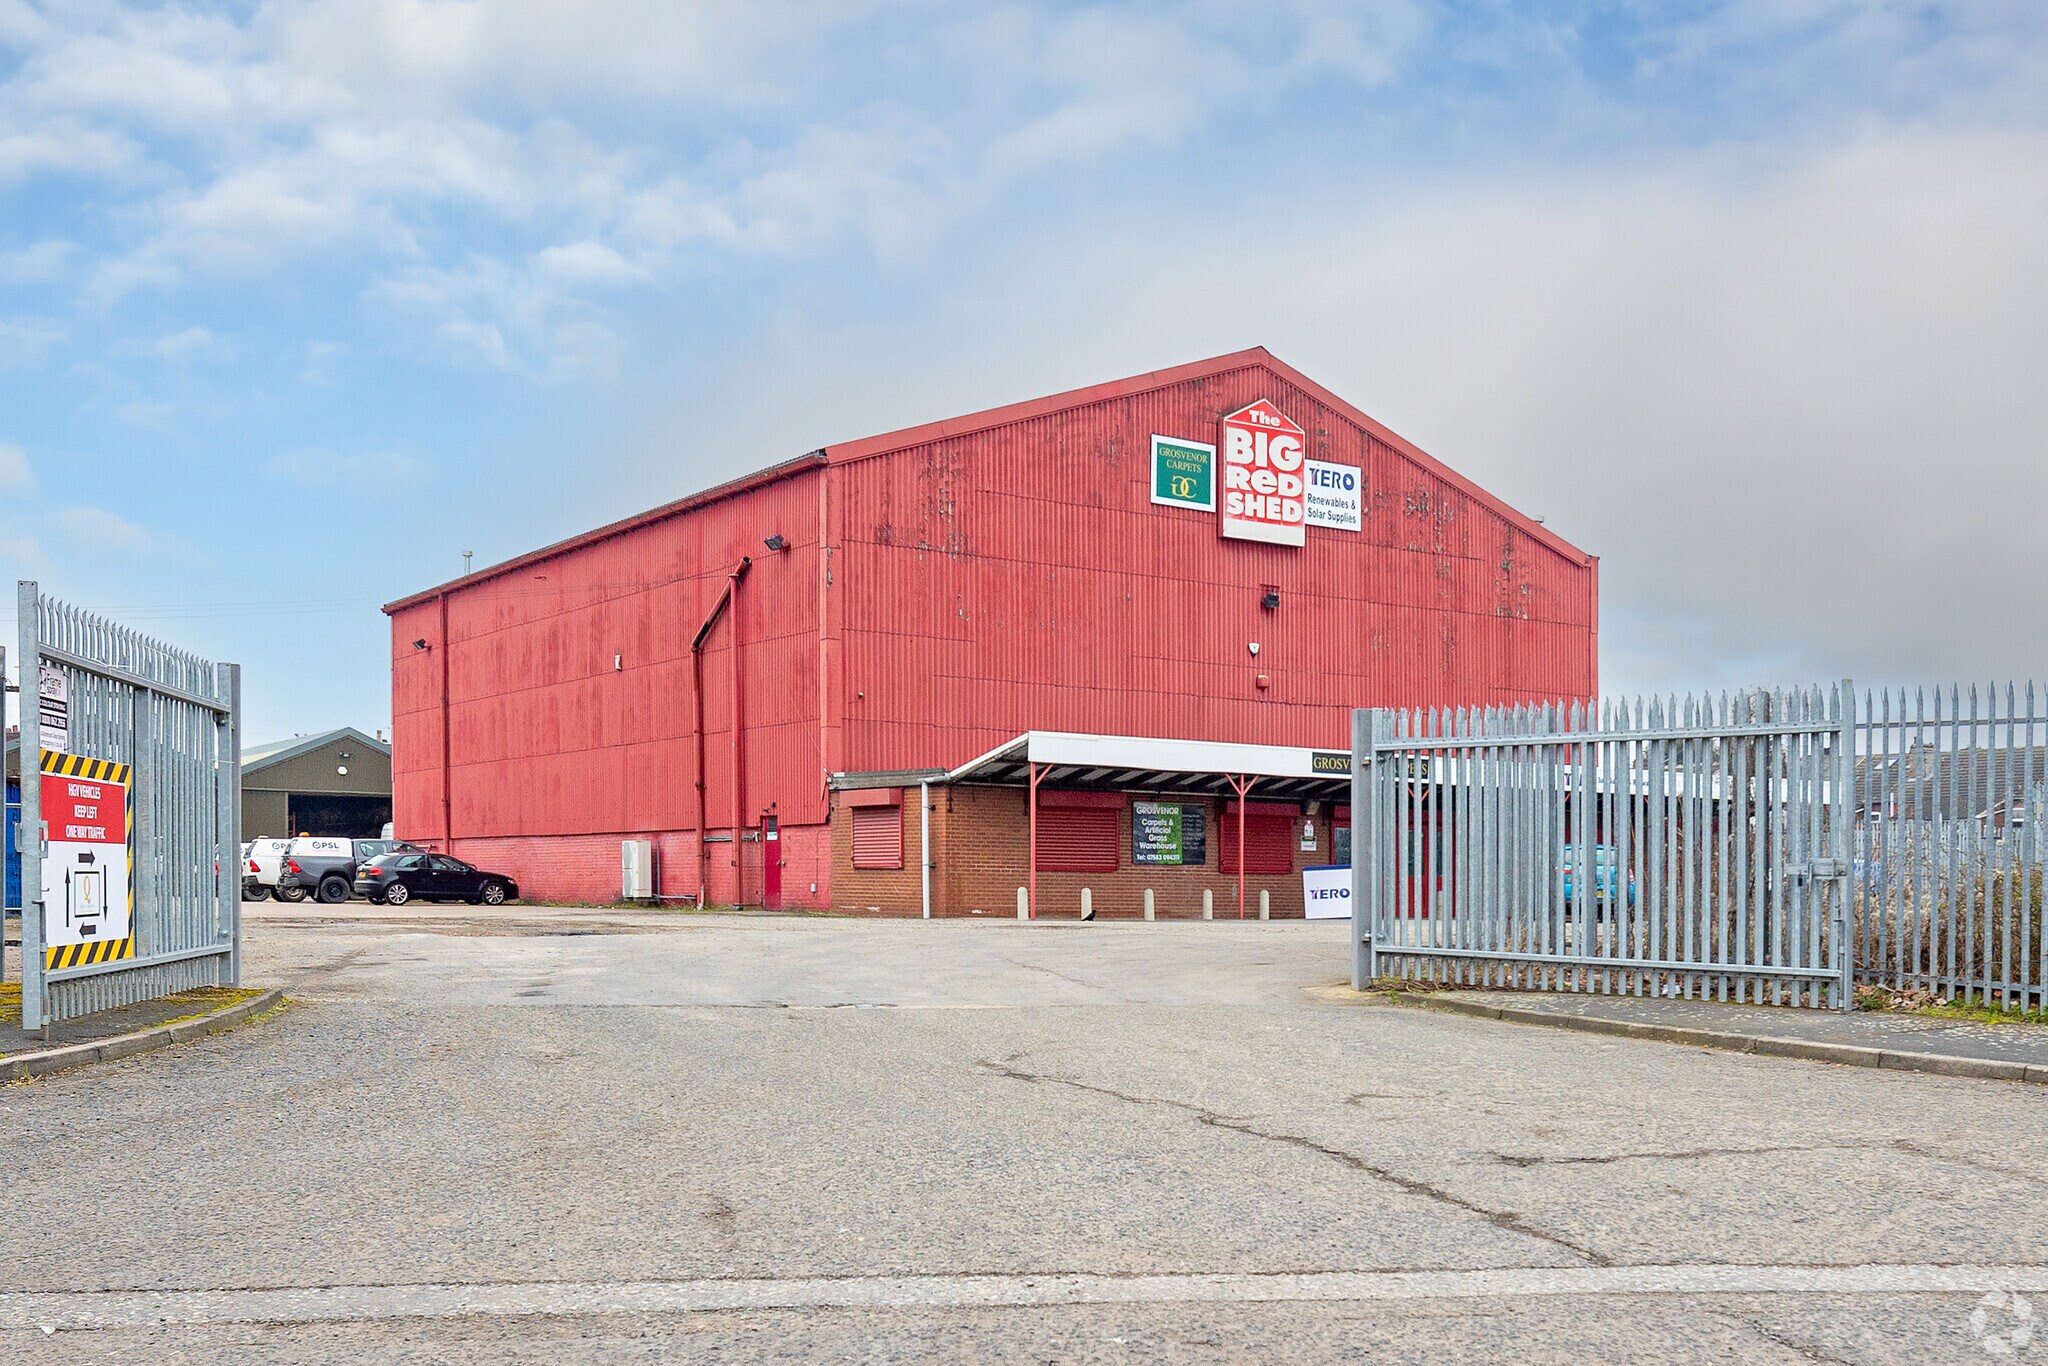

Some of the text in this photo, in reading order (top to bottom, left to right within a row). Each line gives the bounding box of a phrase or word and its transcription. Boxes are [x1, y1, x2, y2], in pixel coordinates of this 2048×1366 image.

[1249, 409, 1281, 427] The
[1159, 447, 1208, 464] GROSVENOR
[1226, 426, 1303, 472] BIG
[1166, 458, 1202, 473] CARPETS
[1227, 492, 1303, 522] SHED
[1307, 493, 1356, 510] Renewables &
[1307, 507, 1357, 524] Solar Supplies
[1313, 756, 1352, 770] GROSV
[79, 785, 101, 800] VEHICLES
[74, 804, 97, 819] KEEP LEFT
[1136, 806, 1179, 814] GROSVENOR
[1141, 818, 1167, 827] Carpets
[66, 824, 106, 839] ONE WAY TRAFFIC
[1148, 834, 1168, 842] Grass
[1139, 842, 1177, 850] Warehouse
